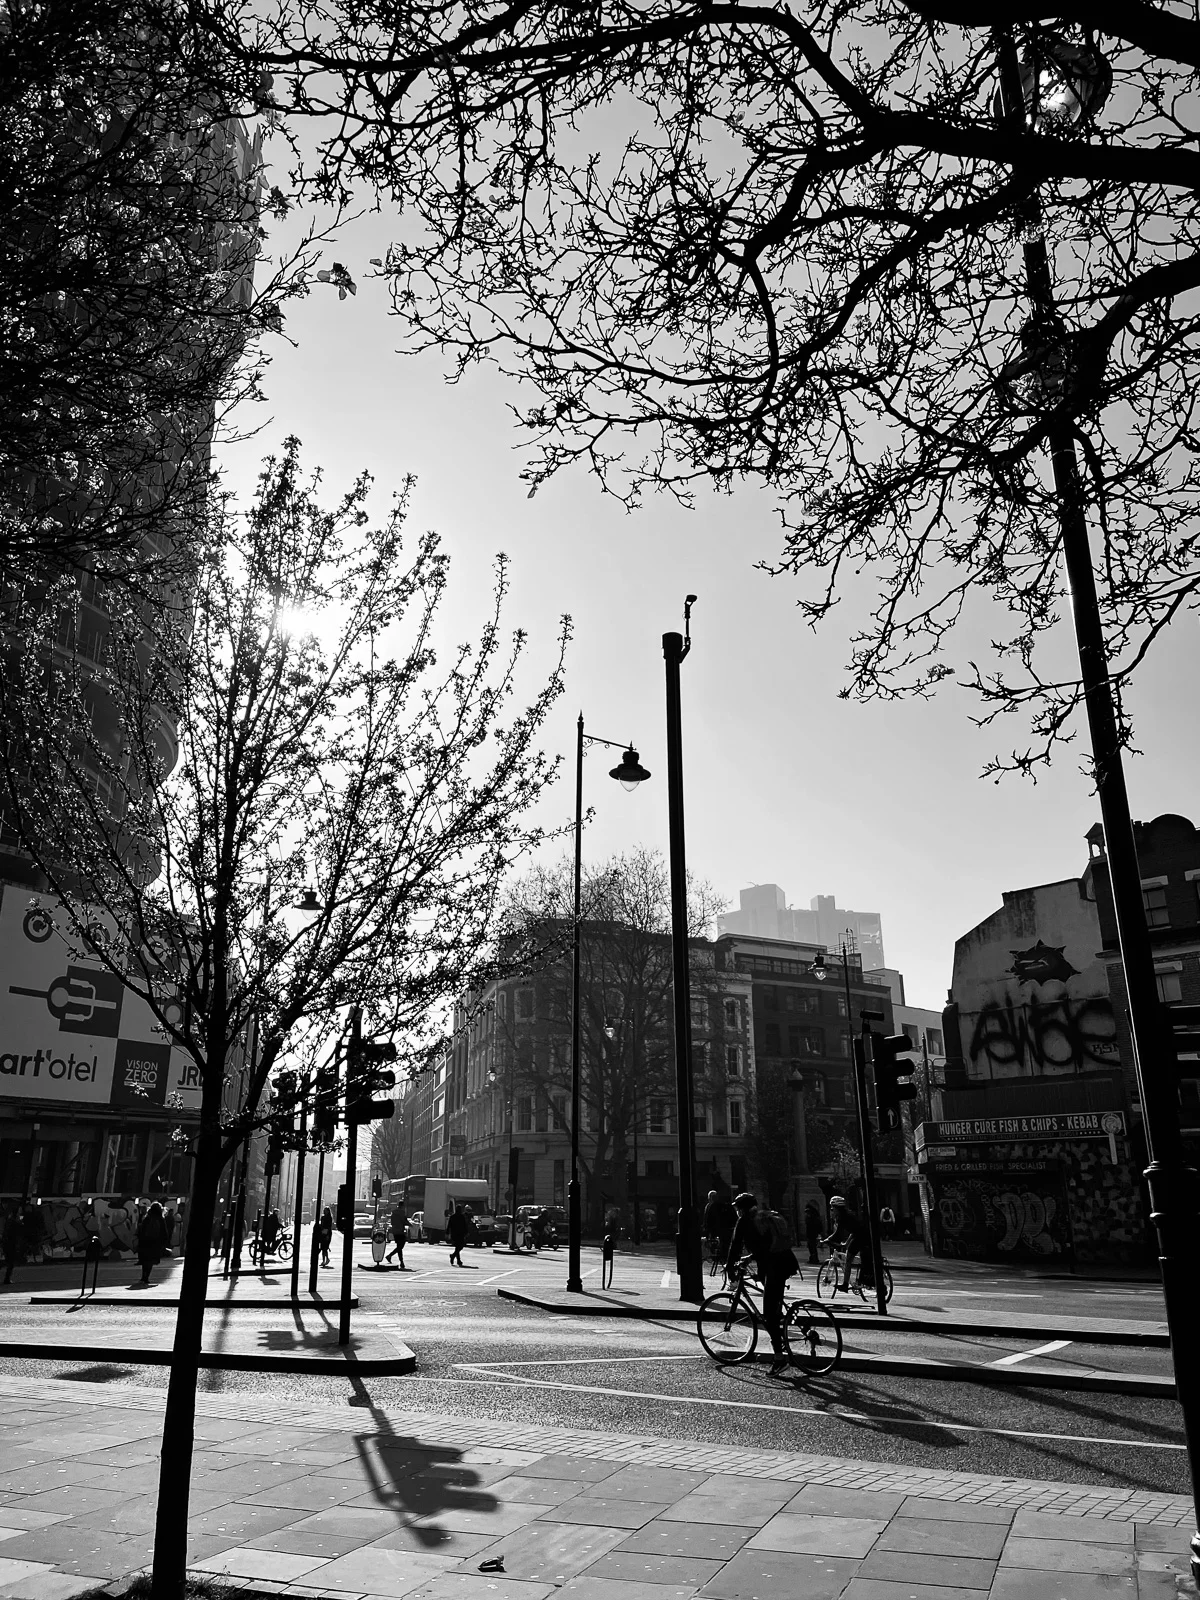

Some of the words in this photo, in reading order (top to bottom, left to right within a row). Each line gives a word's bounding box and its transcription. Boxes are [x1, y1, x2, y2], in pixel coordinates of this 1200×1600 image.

[126, 1059, 158, 1072] VISION
[124, 1068, 158, 1083] ZERO
[939, 1121, 972, 1135] HUNGER
[974, 1119, 996, 1134] CURE
[1000, 1118, 1019, 1133] FISH
[1021, 1118, 1029, 1131] &
[1030, 1117, 1058, 1131] CHIPS
[1067, 1115, 1099, 1130] KEBAB
[935, 1163, 953, 1171] FRIED
[954, 1163, 959, 1171] &
[961, 1163, 987, 1171] GRILLED
[990, 1163, 1004, 1171] FISH
[1007, 1161, 1047, 1170] SPECIALIST
